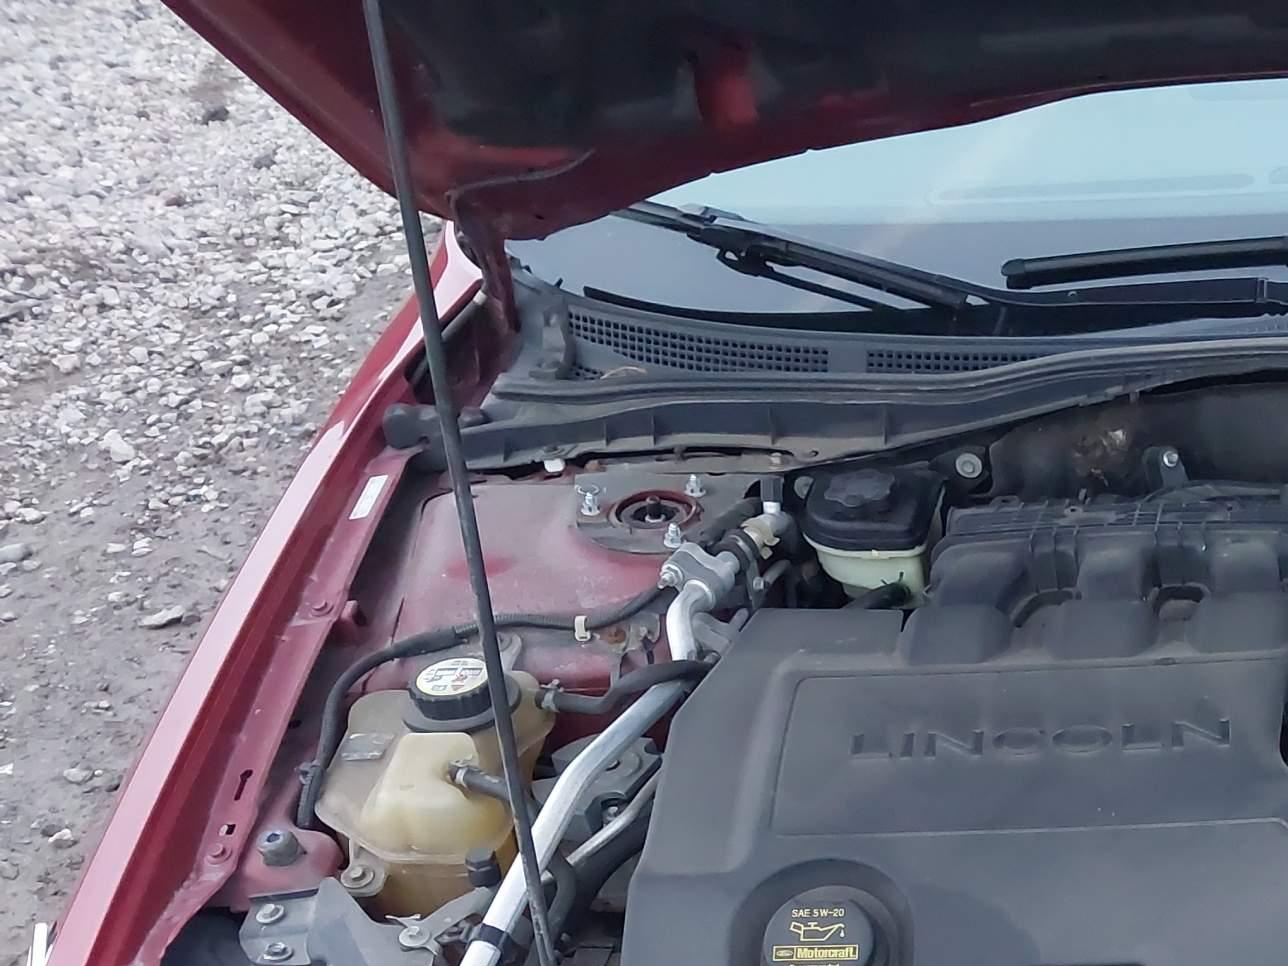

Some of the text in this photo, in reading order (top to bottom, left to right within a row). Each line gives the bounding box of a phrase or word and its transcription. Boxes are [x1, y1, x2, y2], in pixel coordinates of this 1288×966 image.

[850, 718, 1231, 759] LINCOLN
[791, 909, 811, 918] SAE
[797, 947, 857, 959] Motorcraft
